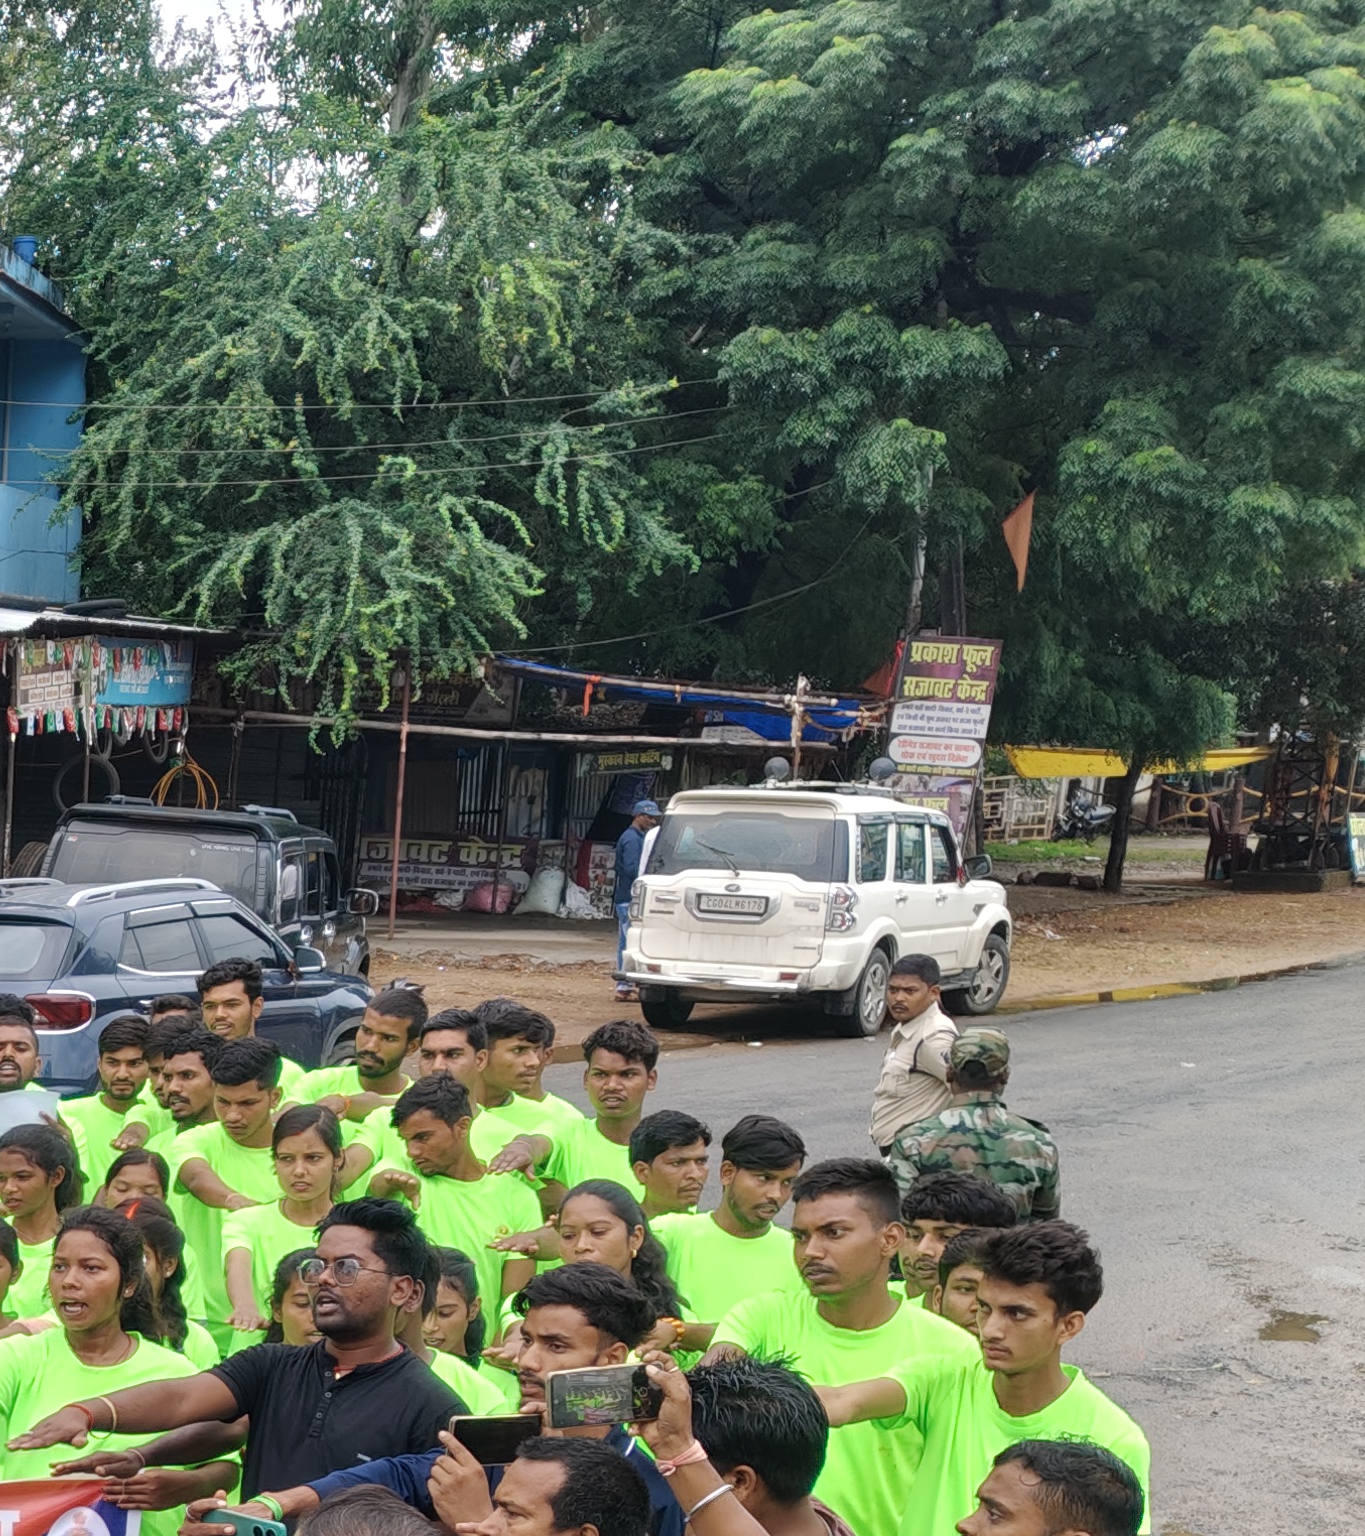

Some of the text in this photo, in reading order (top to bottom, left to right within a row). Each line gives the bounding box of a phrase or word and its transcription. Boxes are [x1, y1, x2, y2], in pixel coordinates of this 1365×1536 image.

[910, 641, 995, 672] प्रकाश फूल
[903, 676, 956, 699] सजावट
[359, 834, 526, 870] जावट केन्द्र
